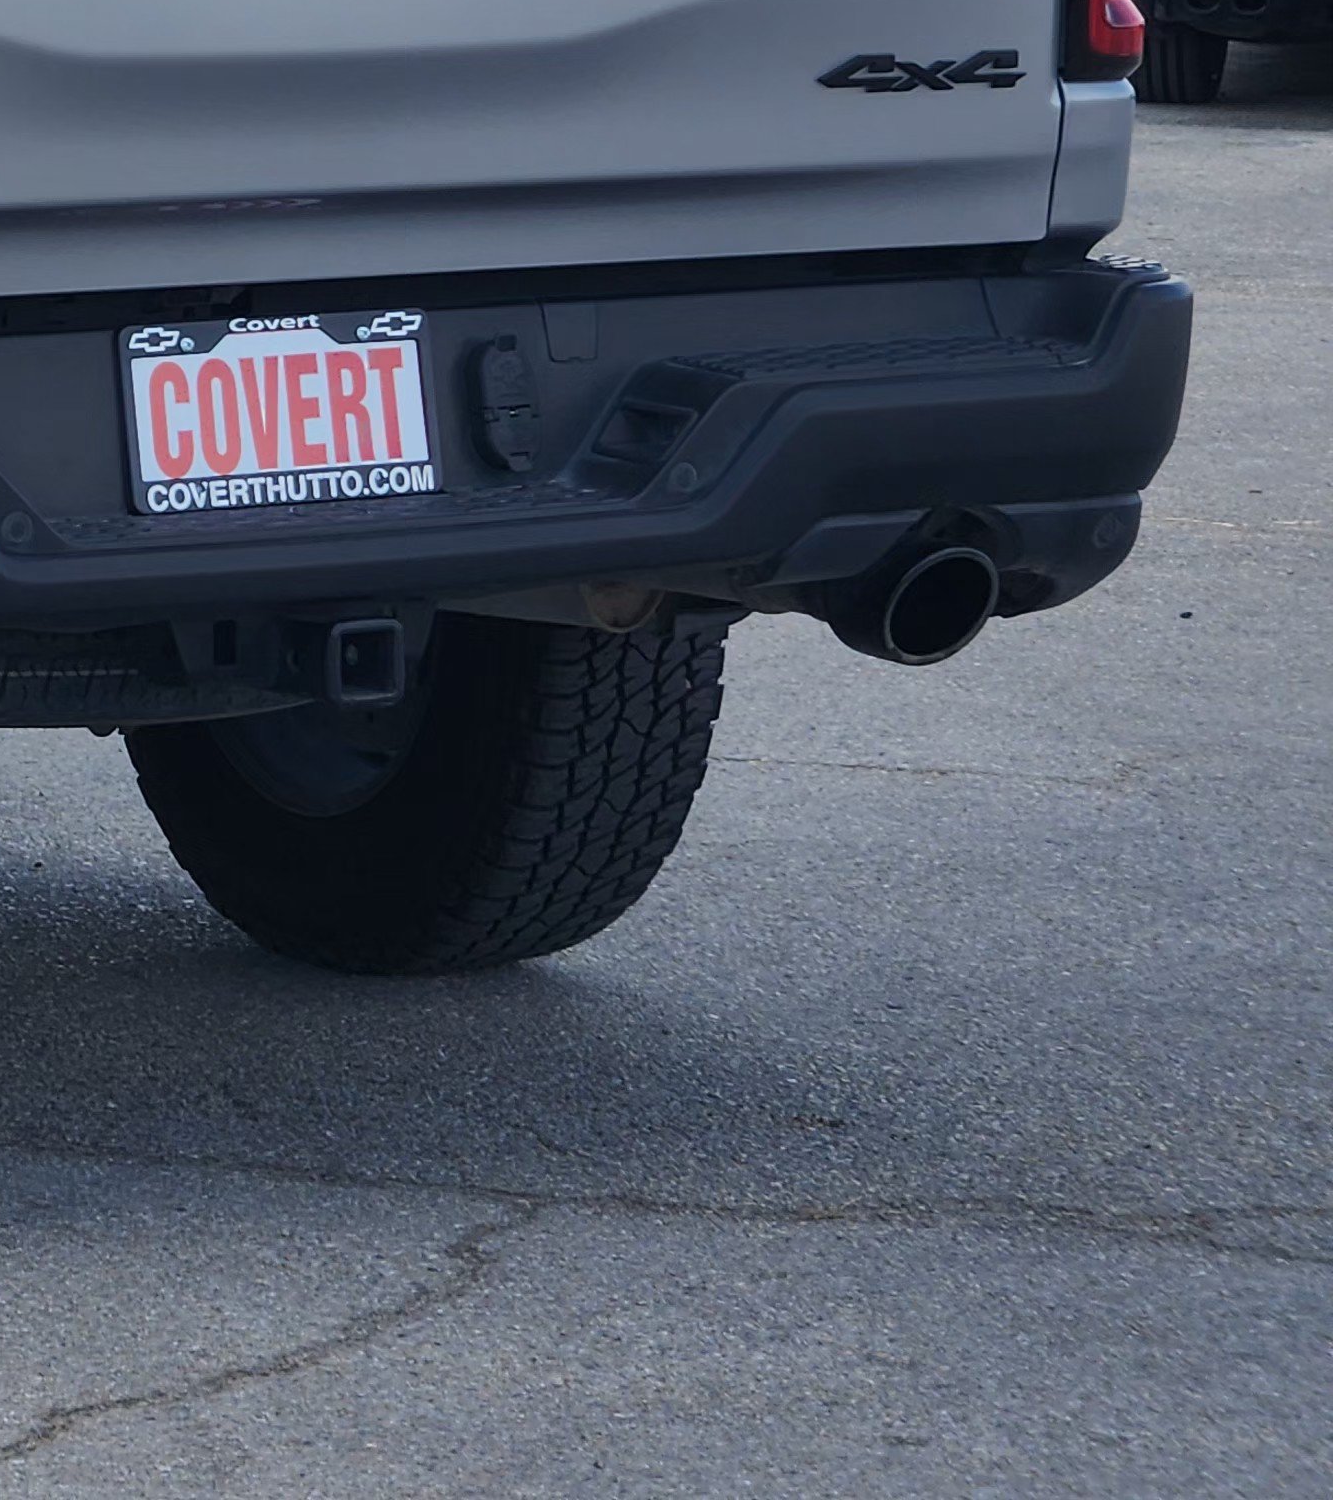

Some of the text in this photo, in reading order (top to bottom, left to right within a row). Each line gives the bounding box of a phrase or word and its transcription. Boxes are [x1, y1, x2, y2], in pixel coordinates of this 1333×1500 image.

[227, 313, 321, 333] Covert
[148, 346, 404, 480] COVERT
[146, 464, 435, 514] COVERTHUTTO.COM
